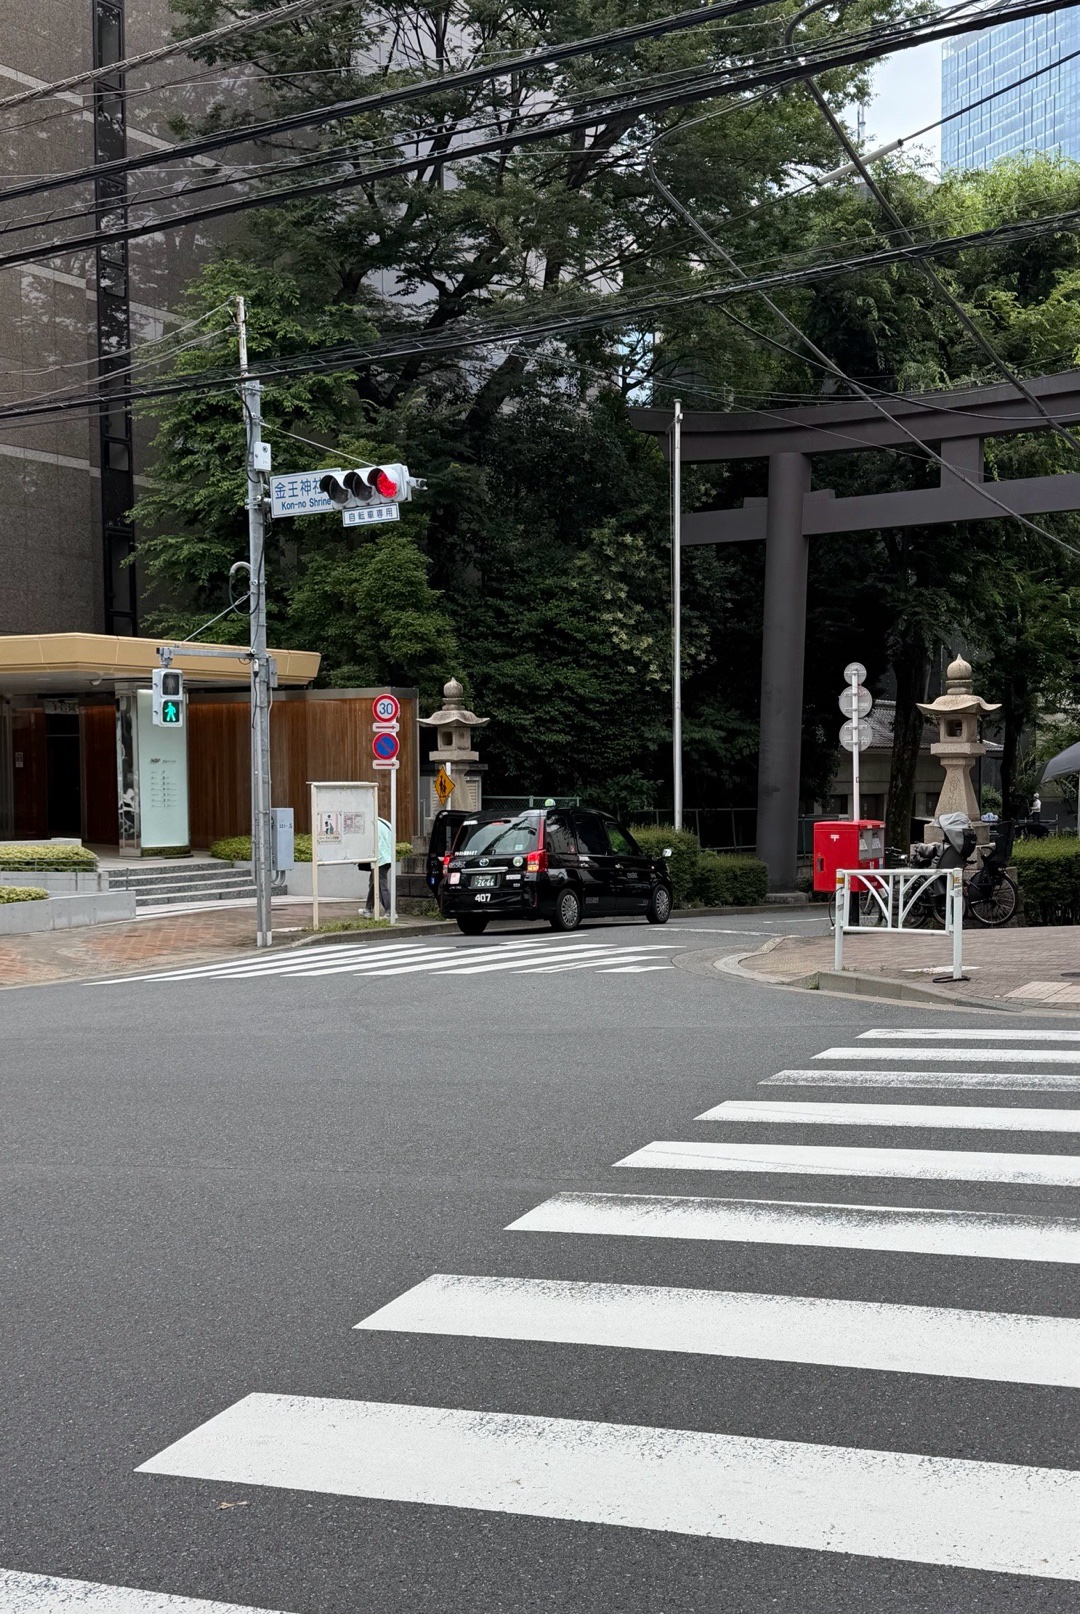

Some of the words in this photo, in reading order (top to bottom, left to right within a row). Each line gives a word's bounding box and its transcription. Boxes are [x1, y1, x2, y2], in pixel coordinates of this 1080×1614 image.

[281, 500, 307, 511] Kon-no
[309, 497, 332, 508] Shrine
[348, 507, 393, 522] 自転車専用
[379, 703, 393, 715] 30
[474, 893, 491, 902] 407
